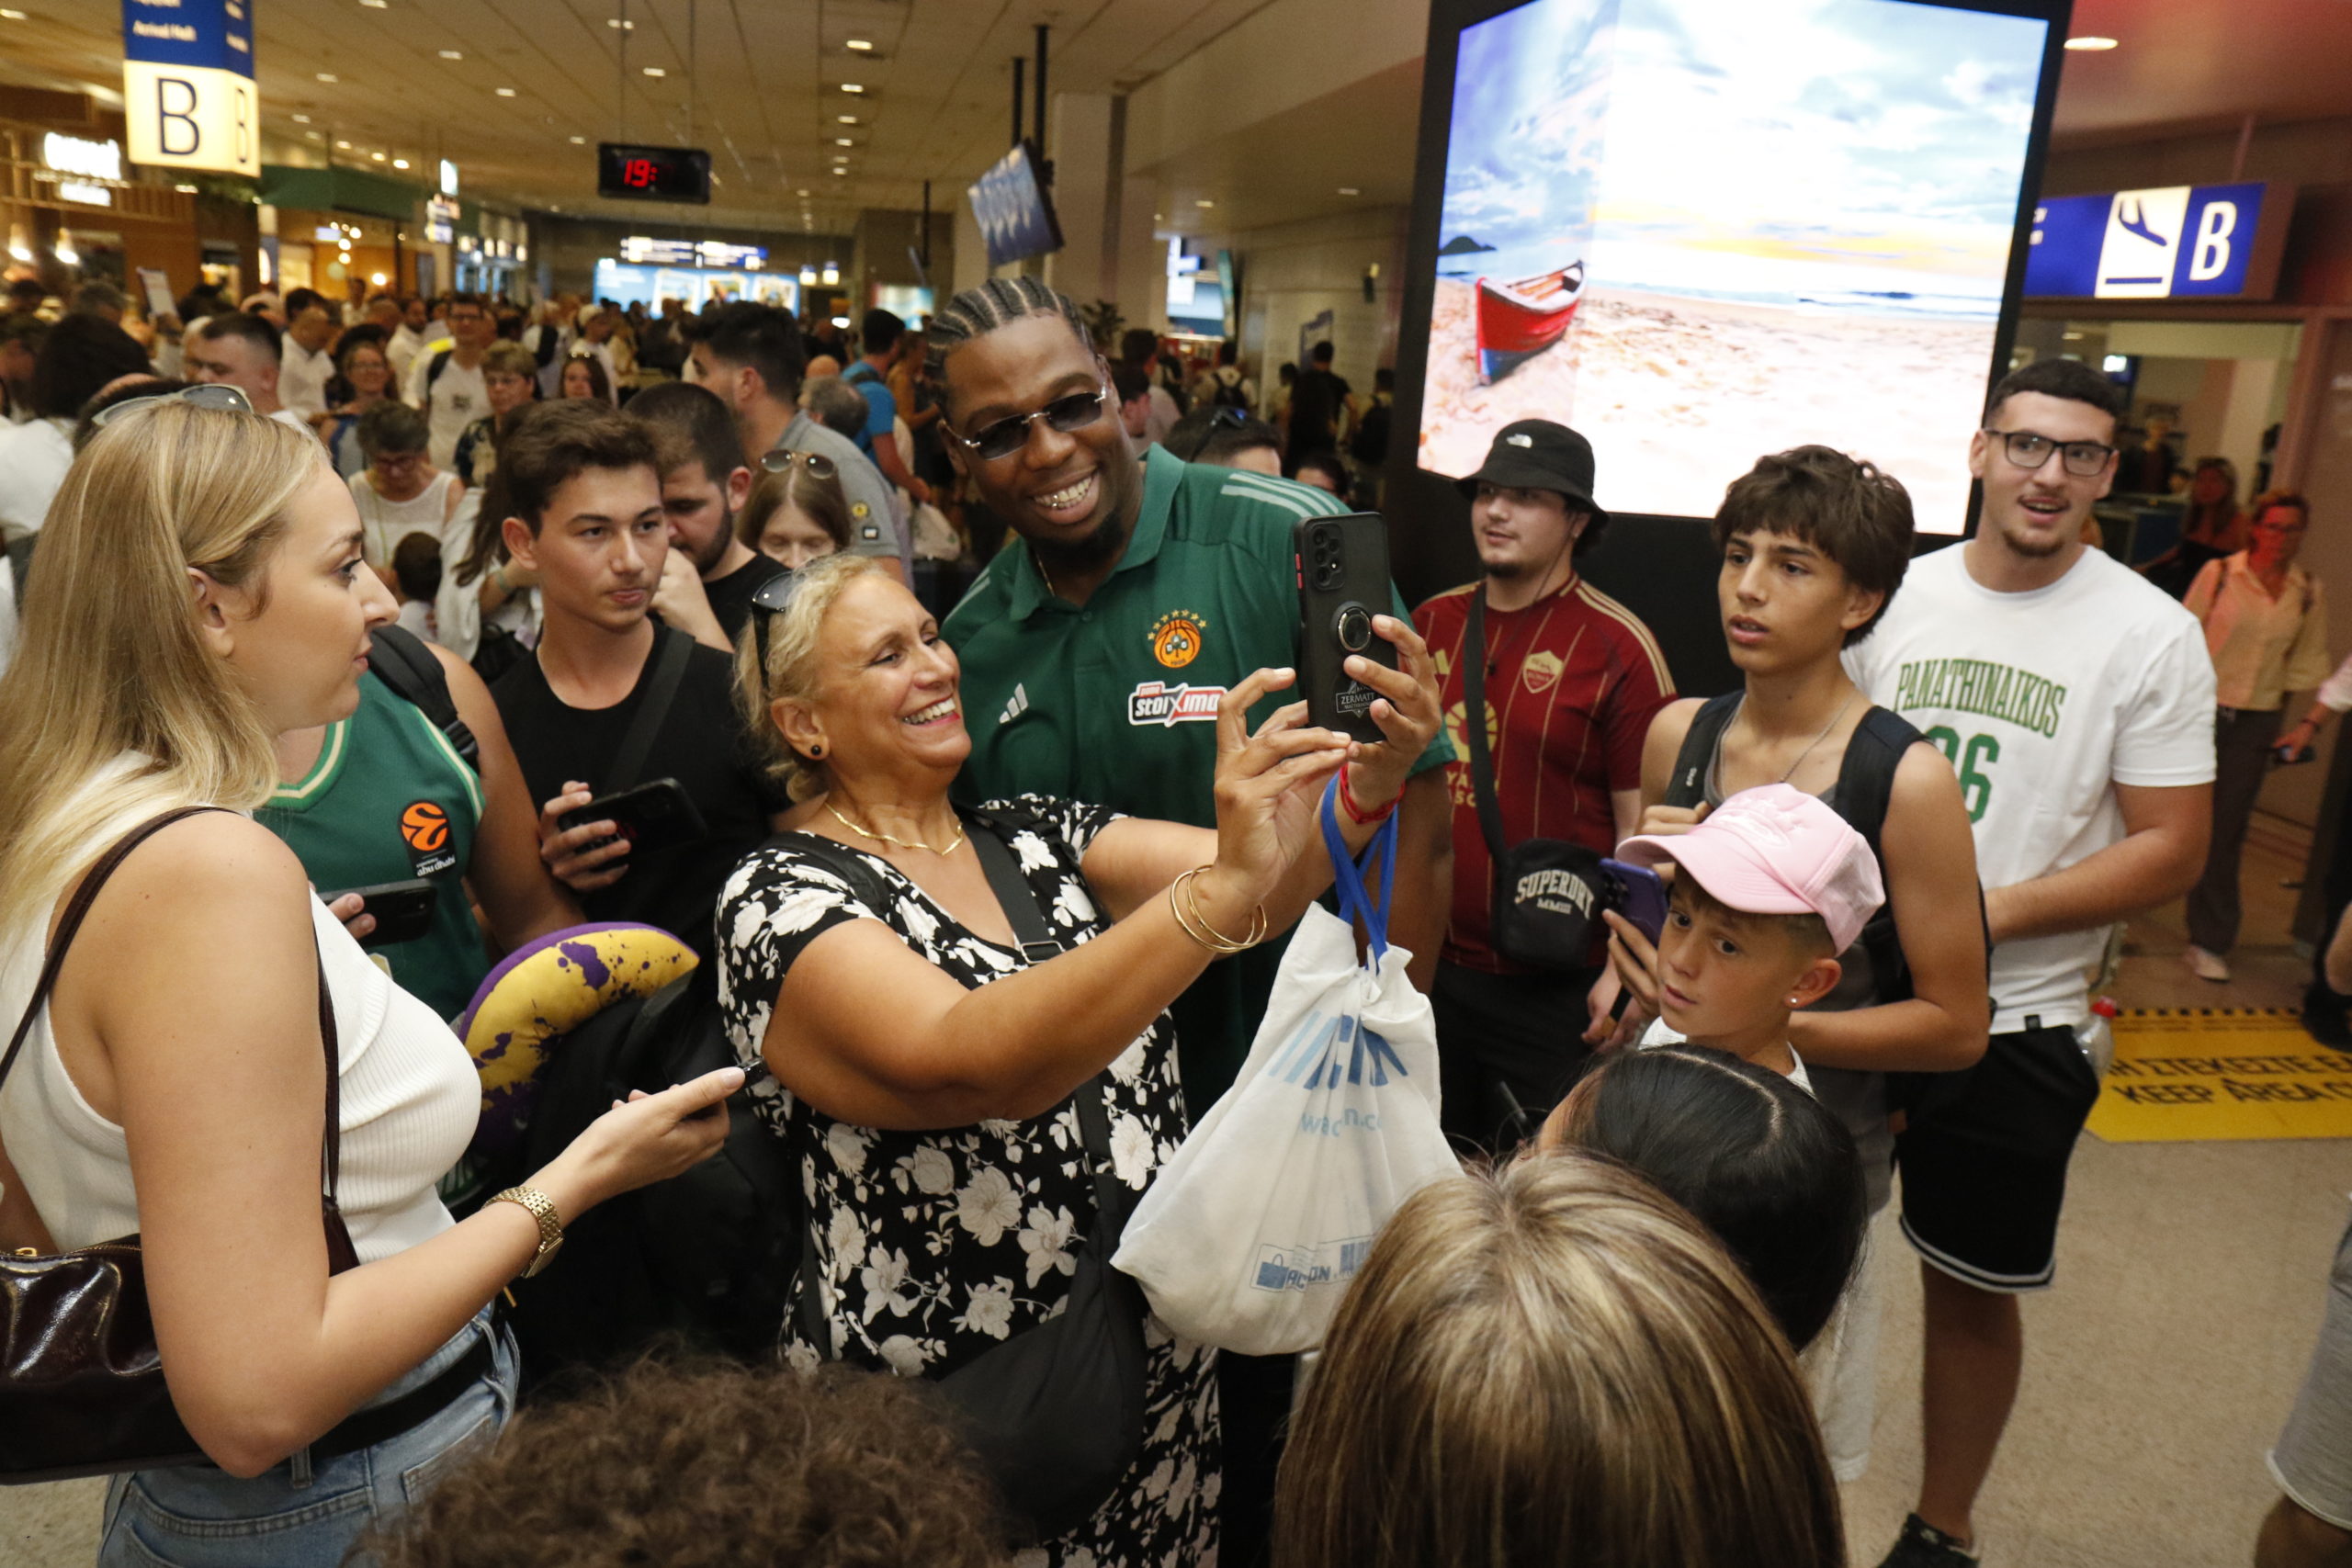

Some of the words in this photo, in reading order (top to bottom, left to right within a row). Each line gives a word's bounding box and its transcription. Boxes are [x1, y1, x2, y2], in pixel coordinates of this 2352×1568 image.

[157, 77, 199, 155] B
[2188, 201, 2238, 281] B
[1341, 692, 1374, 705] ZERMATT
[1894, 658, 2066, 739] PANATHINAIKOS
[1514, 869, 1595, 920] SUPERDRY
[2111, 1084, 2214, 1105] KEEP
[2221, 1077, 2339, 1102] AREA
